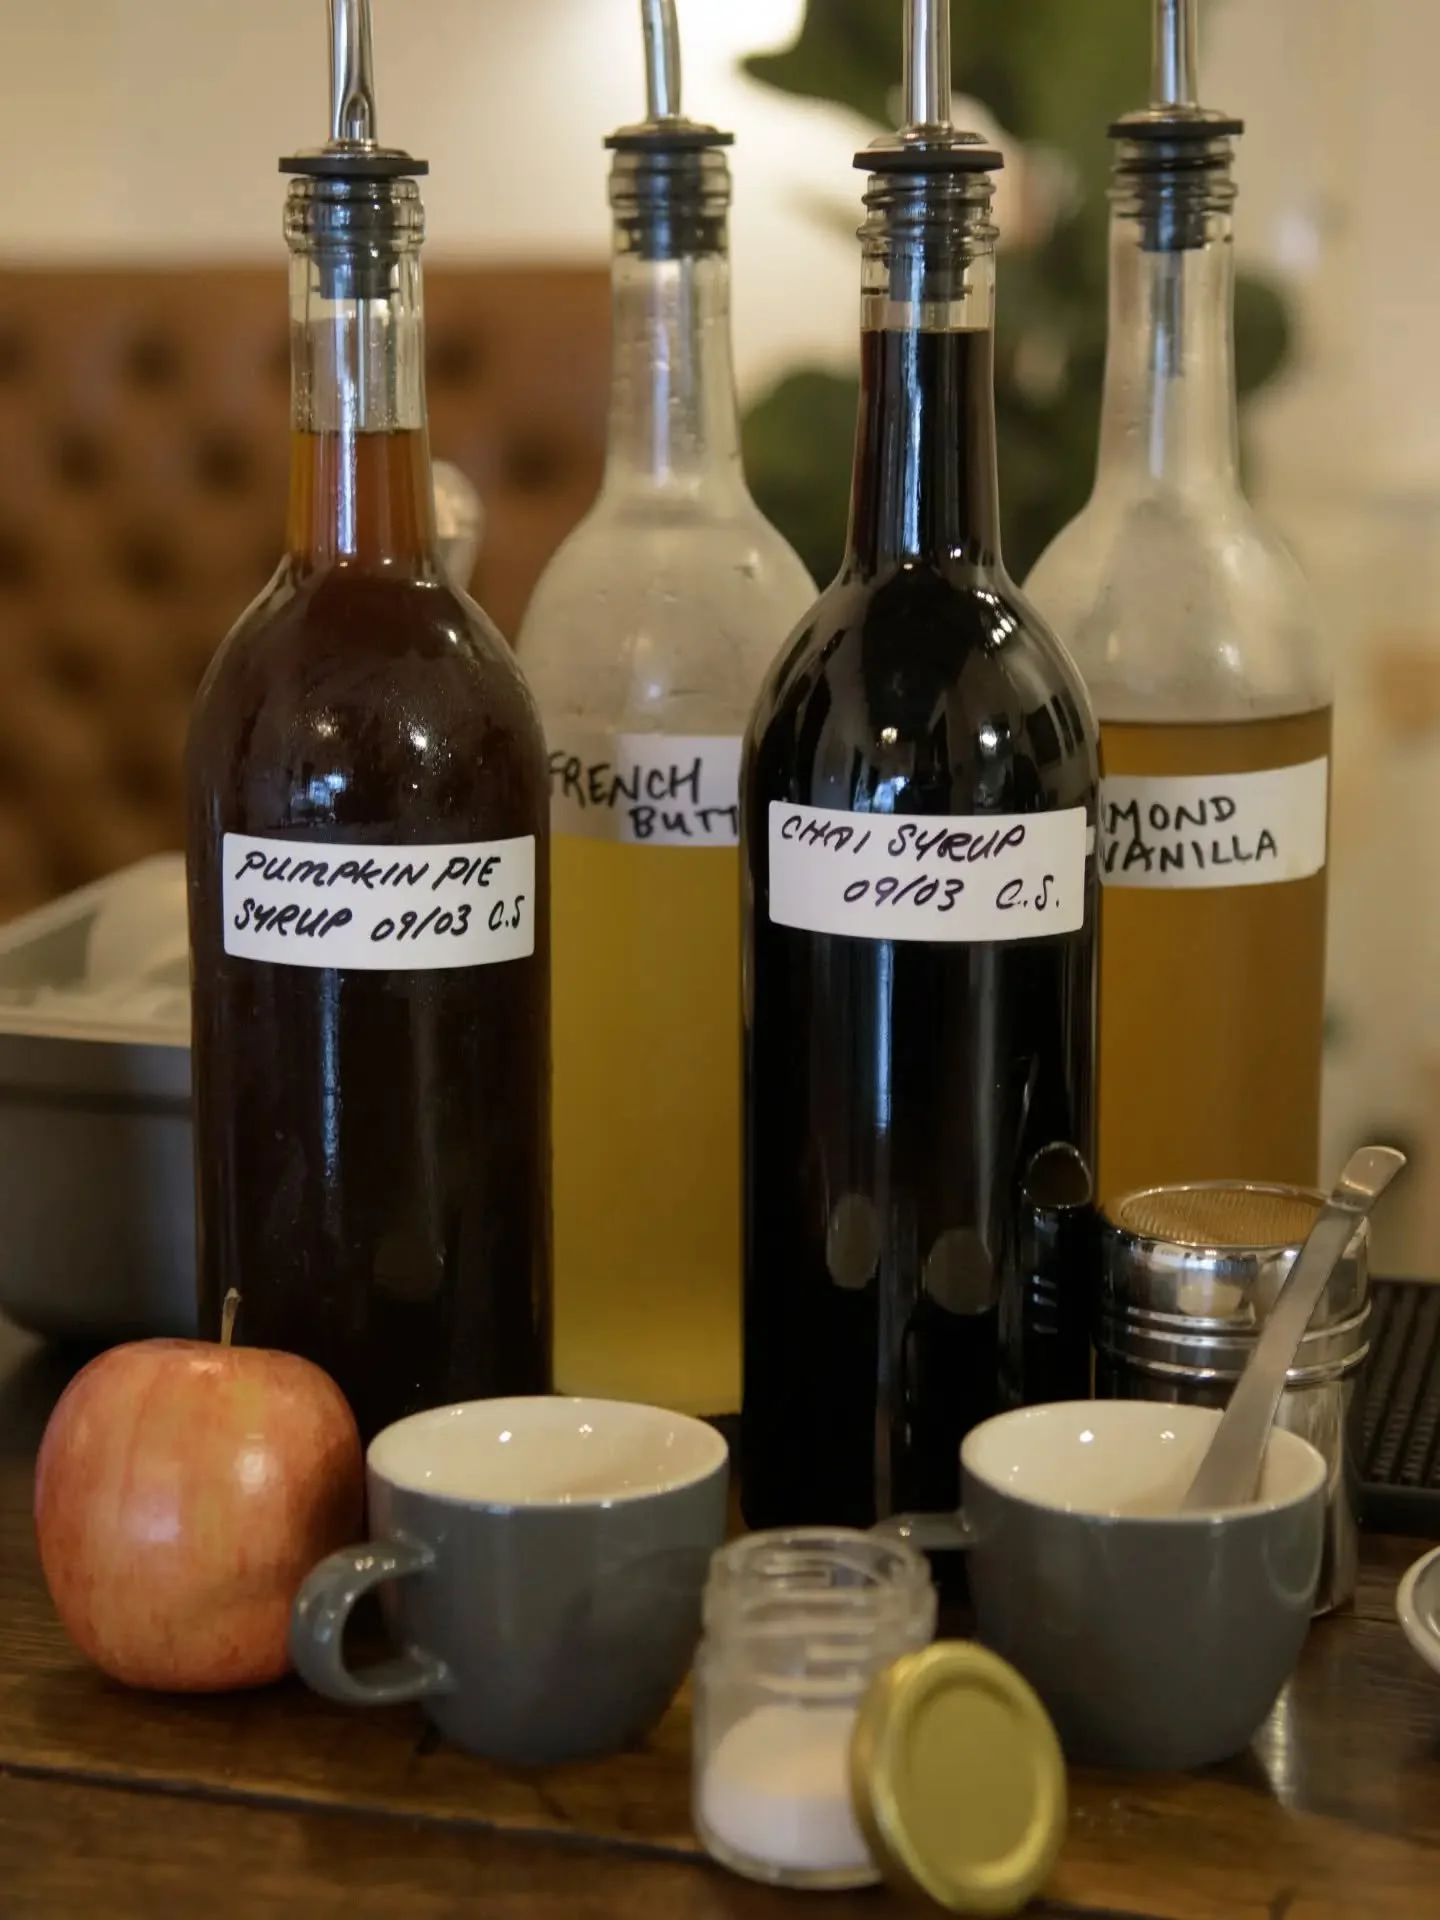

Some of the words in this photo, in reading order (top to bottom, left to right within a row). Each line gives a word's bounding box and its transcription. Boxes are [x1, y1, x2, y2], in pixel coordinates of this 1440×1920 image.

[1102, 796, 1236, 843] MOND
[888, 823, 1025, 862] SYRUP
[1102, 829, 1278, 873] VANILLA
[235, 850, 430, 889] PUMPKIN
[431, 856, 502, 890] PIE
[843, 874, 964, 911] 09/03
[234, 898, 353, 938] SYRUP
[370, 903, 472, 942] 09/03
